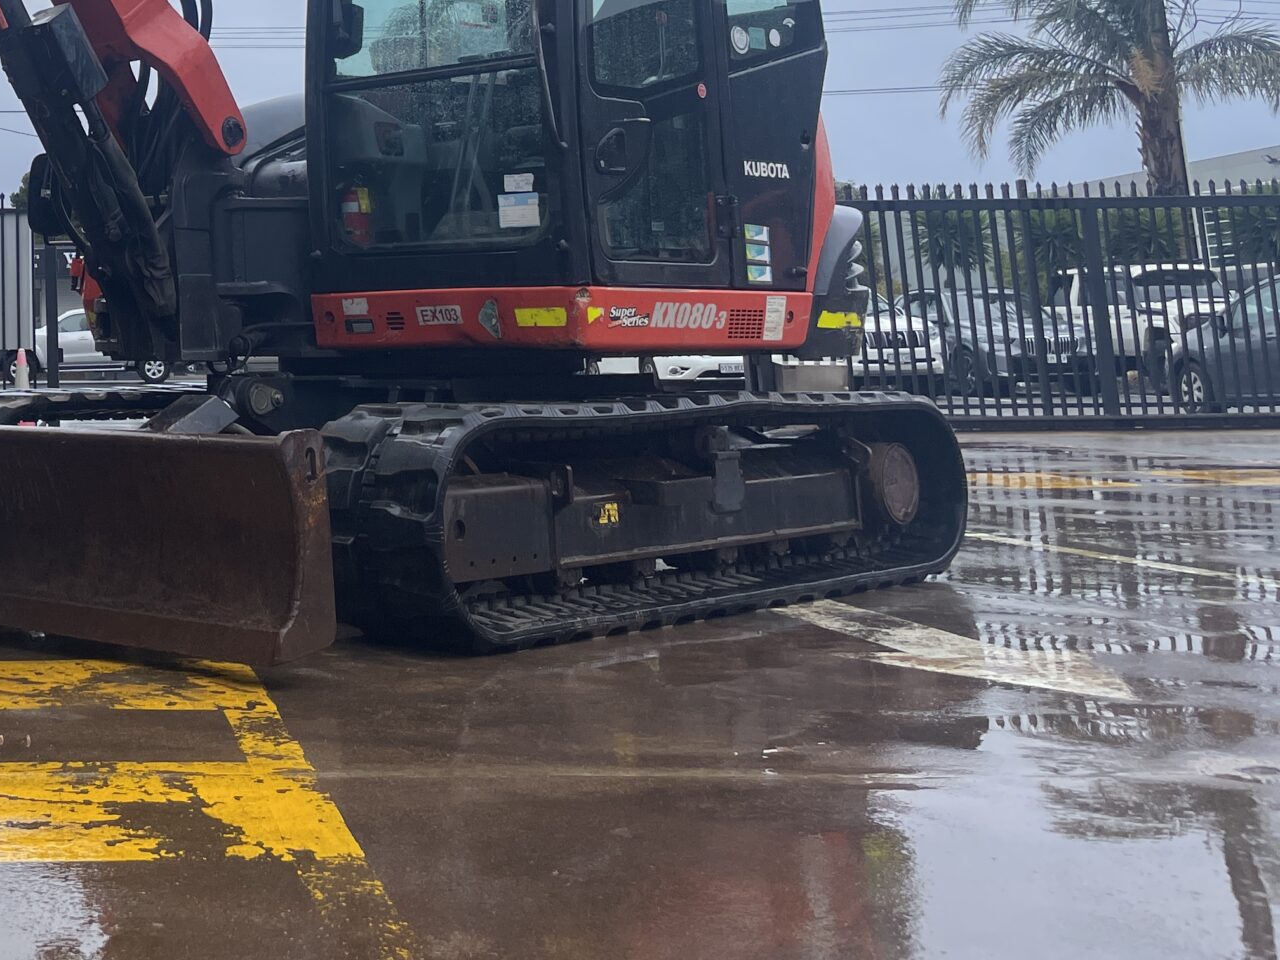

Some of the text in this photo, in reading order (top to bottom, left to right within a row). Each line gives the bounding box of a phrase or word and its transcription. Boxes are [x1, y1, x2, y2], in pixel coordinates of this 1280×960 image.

[743, 160, 790, 179] KUBOTA
[420, 308, 459, 324] EX103
[609, 301, 727, 329] Super KX080-3
[620, 314, 650, 328] Series
